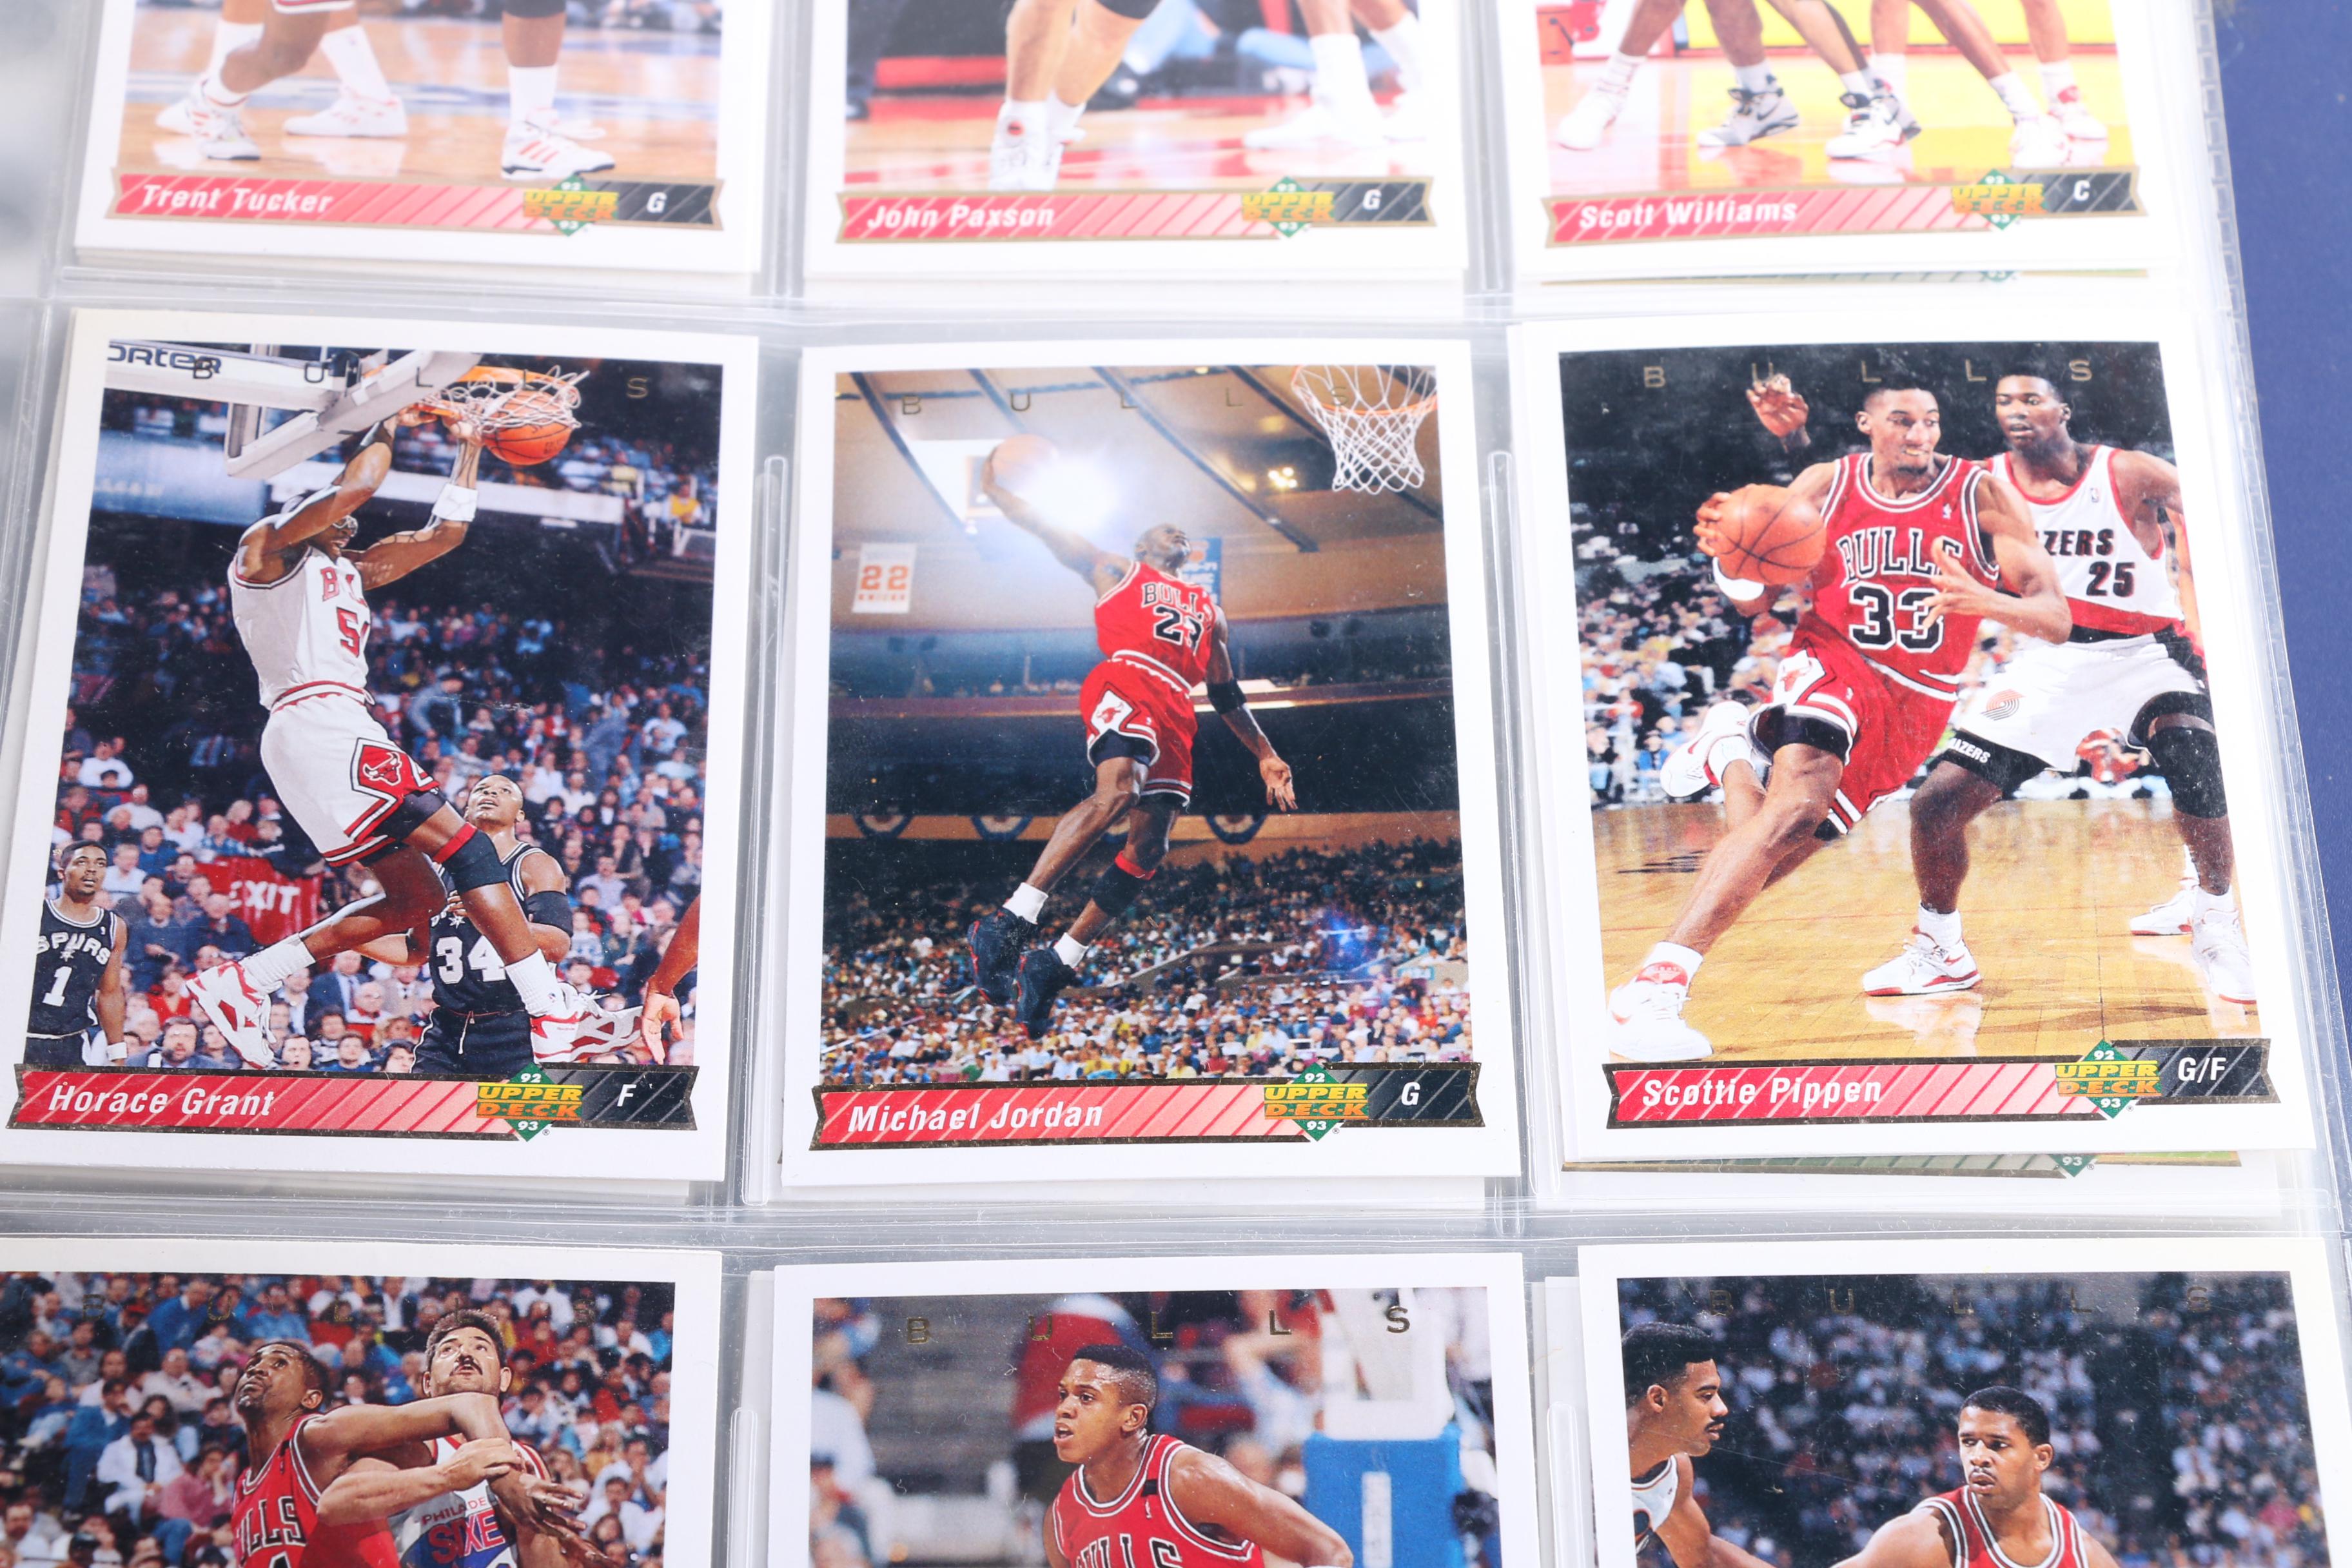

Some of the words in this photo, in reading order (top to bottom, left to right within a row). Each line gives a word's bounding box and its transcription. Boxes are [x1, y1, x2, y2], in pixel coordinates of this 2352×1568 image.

[142, 184, 220, 210] Trent
[232, 187, 334, 213] Tucker
[647, 192, 667, 213] G
[1362, 190, 1382, 210] G
[2072, 180, 2091, 201] C
[867, 205, 939, 229] John
[948, 205, 1055, 228] Paxson
[1580, 204, 1654, 230] Scott
[1665, 200, 1798, 224] Williams
[2035, 528, 2115, 556] ZERS
[860, 565, 909, 591] 22
[2086, 561, 2135, 598] 25
[1141, 582, 1213, 633] BULL
[1848, 580, 1945, 654] 33
[336, 606, 369, 652] 5
[228, 880, 301, 915] EXIT
[37, 932, 112, 965] SPURS
[436, 935, 507, 985] 34
[42, 966, 73, 1007] 1
[2093, 1050, 2115, 1061] 92
[520, 1073, 542, 1083] 92
[1304, 1072, 1326, 1083] 92
[2055, 1064, 2159, 1078] UPPER
[2177, 1057, 2227, 1084] G/F
[48, 1084, 169, 1113] Horace
[181, 1087, 275, 1116] Grant
[478, 1086, 583, 1102] UPPER
[616, 1084, 637, 1108] F
[1265, 1086, 1367, 1101] UPPER
[1400, 1081, 1421, 1106] G
[1642, 1079, 1757, 1107] Scottie
[1770, 1077, 1882, 1110] Pippen
[2100, 1098, 2121, 1108] 93
[517, 1120, 539, 1132] 93
[848, 1102, 982, 1132] Michael
[990, 1101, 1104, 1130] Jordan
[1306, 1121, 1328, 1132] 93
[2062, 1156, 2083, 1166] 93
